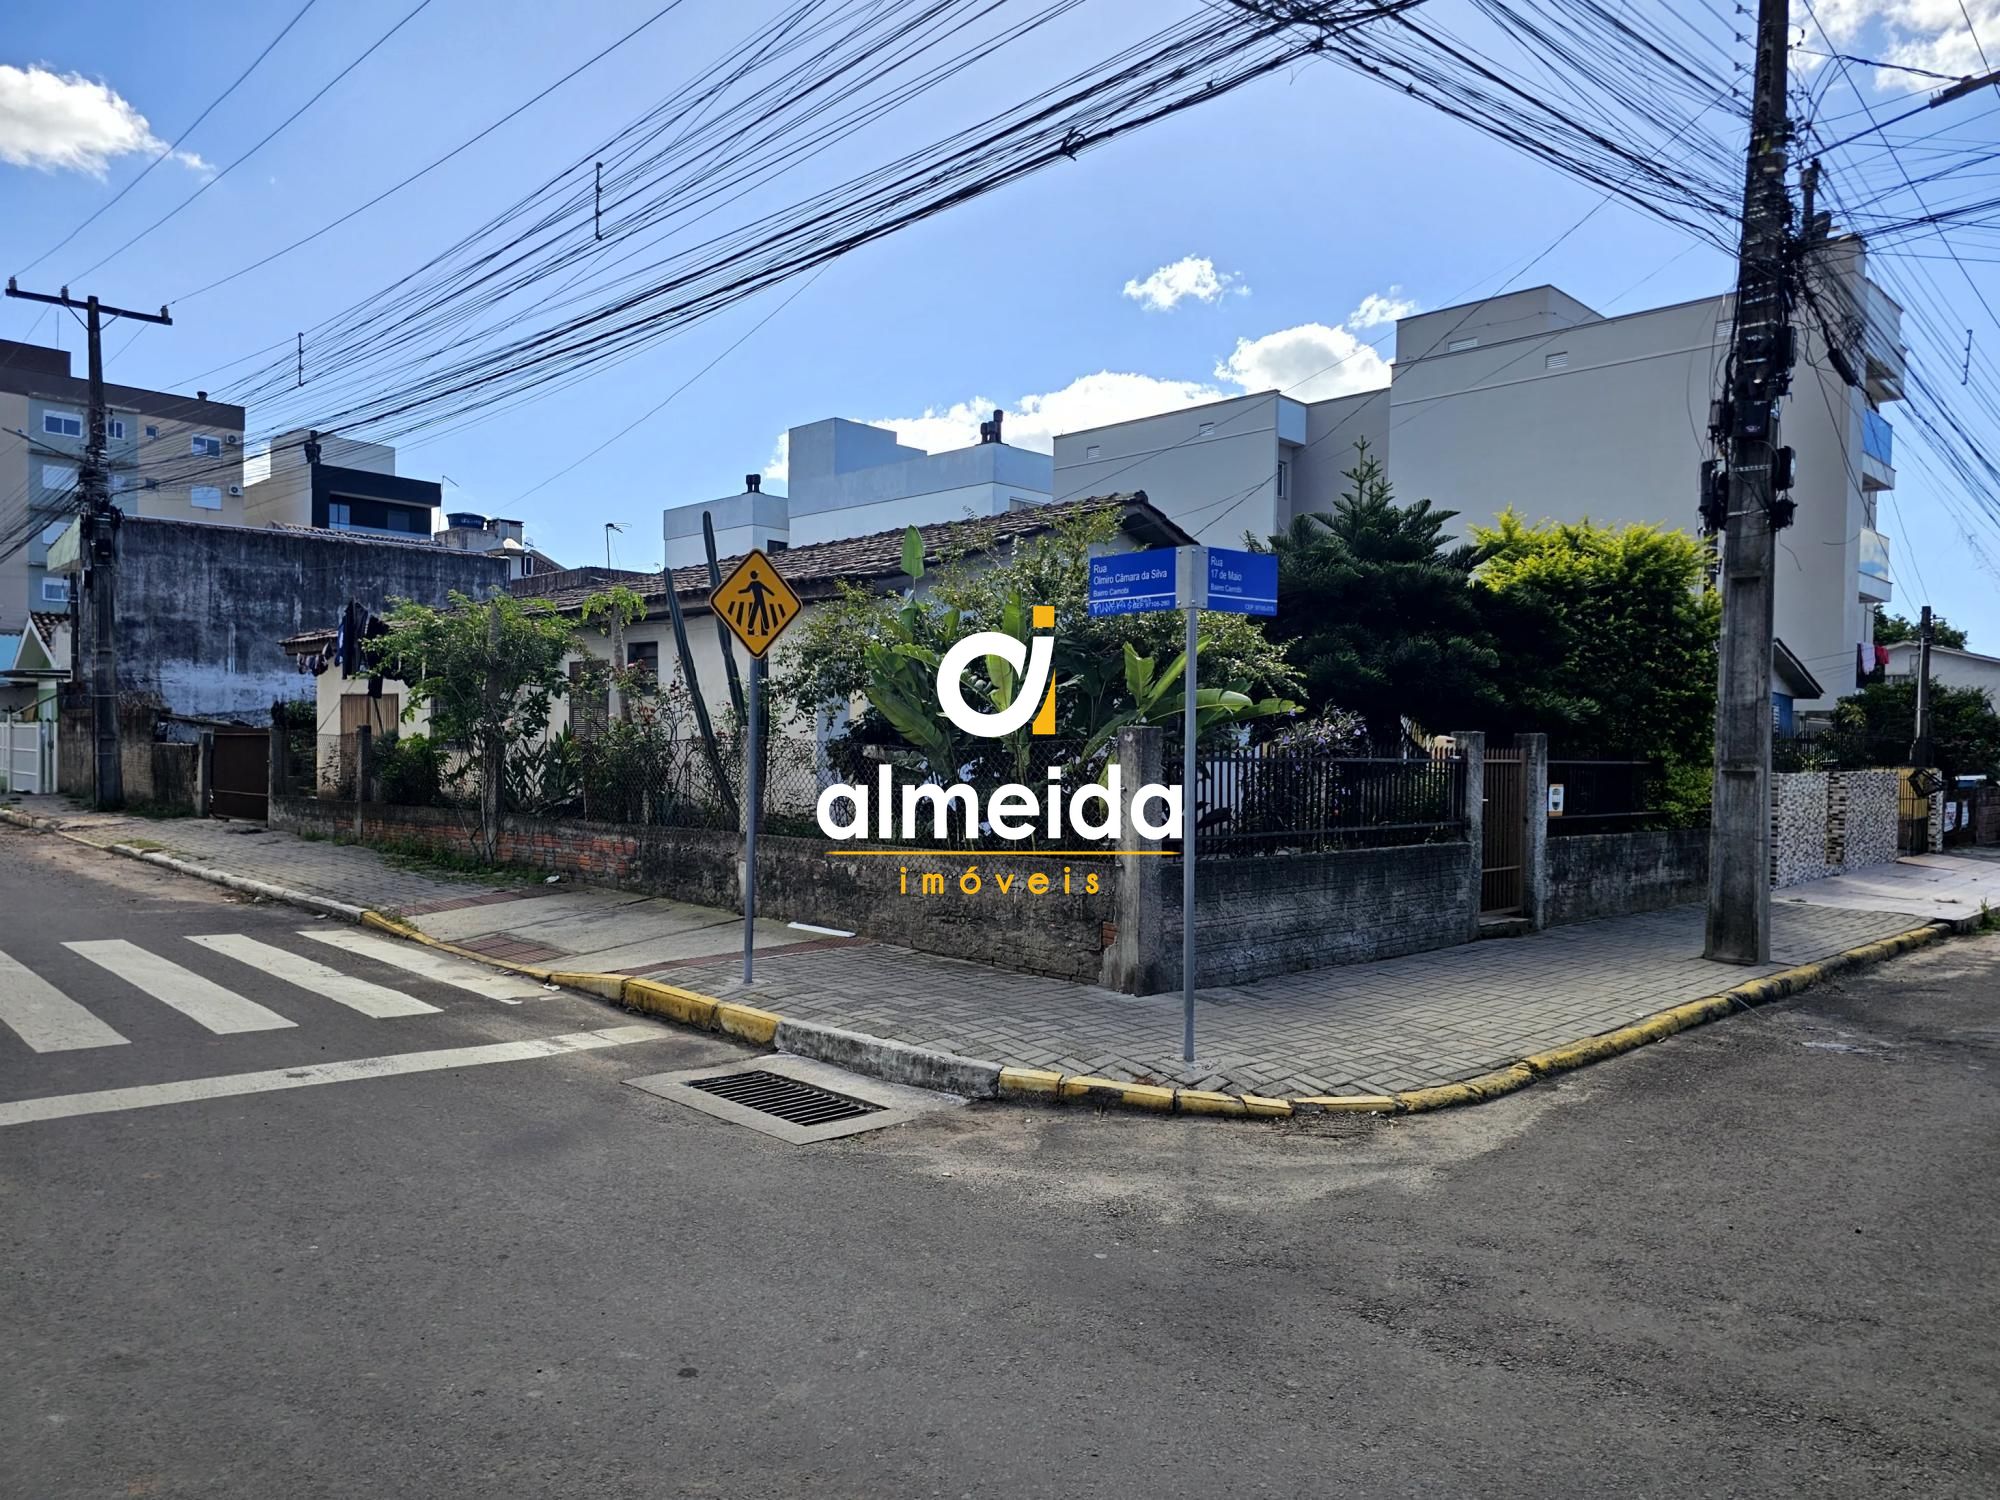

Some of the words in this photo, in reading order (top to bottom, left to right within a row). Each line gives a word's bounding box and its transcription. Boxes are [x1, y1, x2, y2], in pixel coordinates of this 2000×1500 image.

[1210, 556, 1223, 567] Rua
[1093, 564, 1107, 574] Rua
[1211, 569, 1218, 579] 17
[1141, 571, 1150, 580] da
[1151, 569, 1168, 579] Silva
